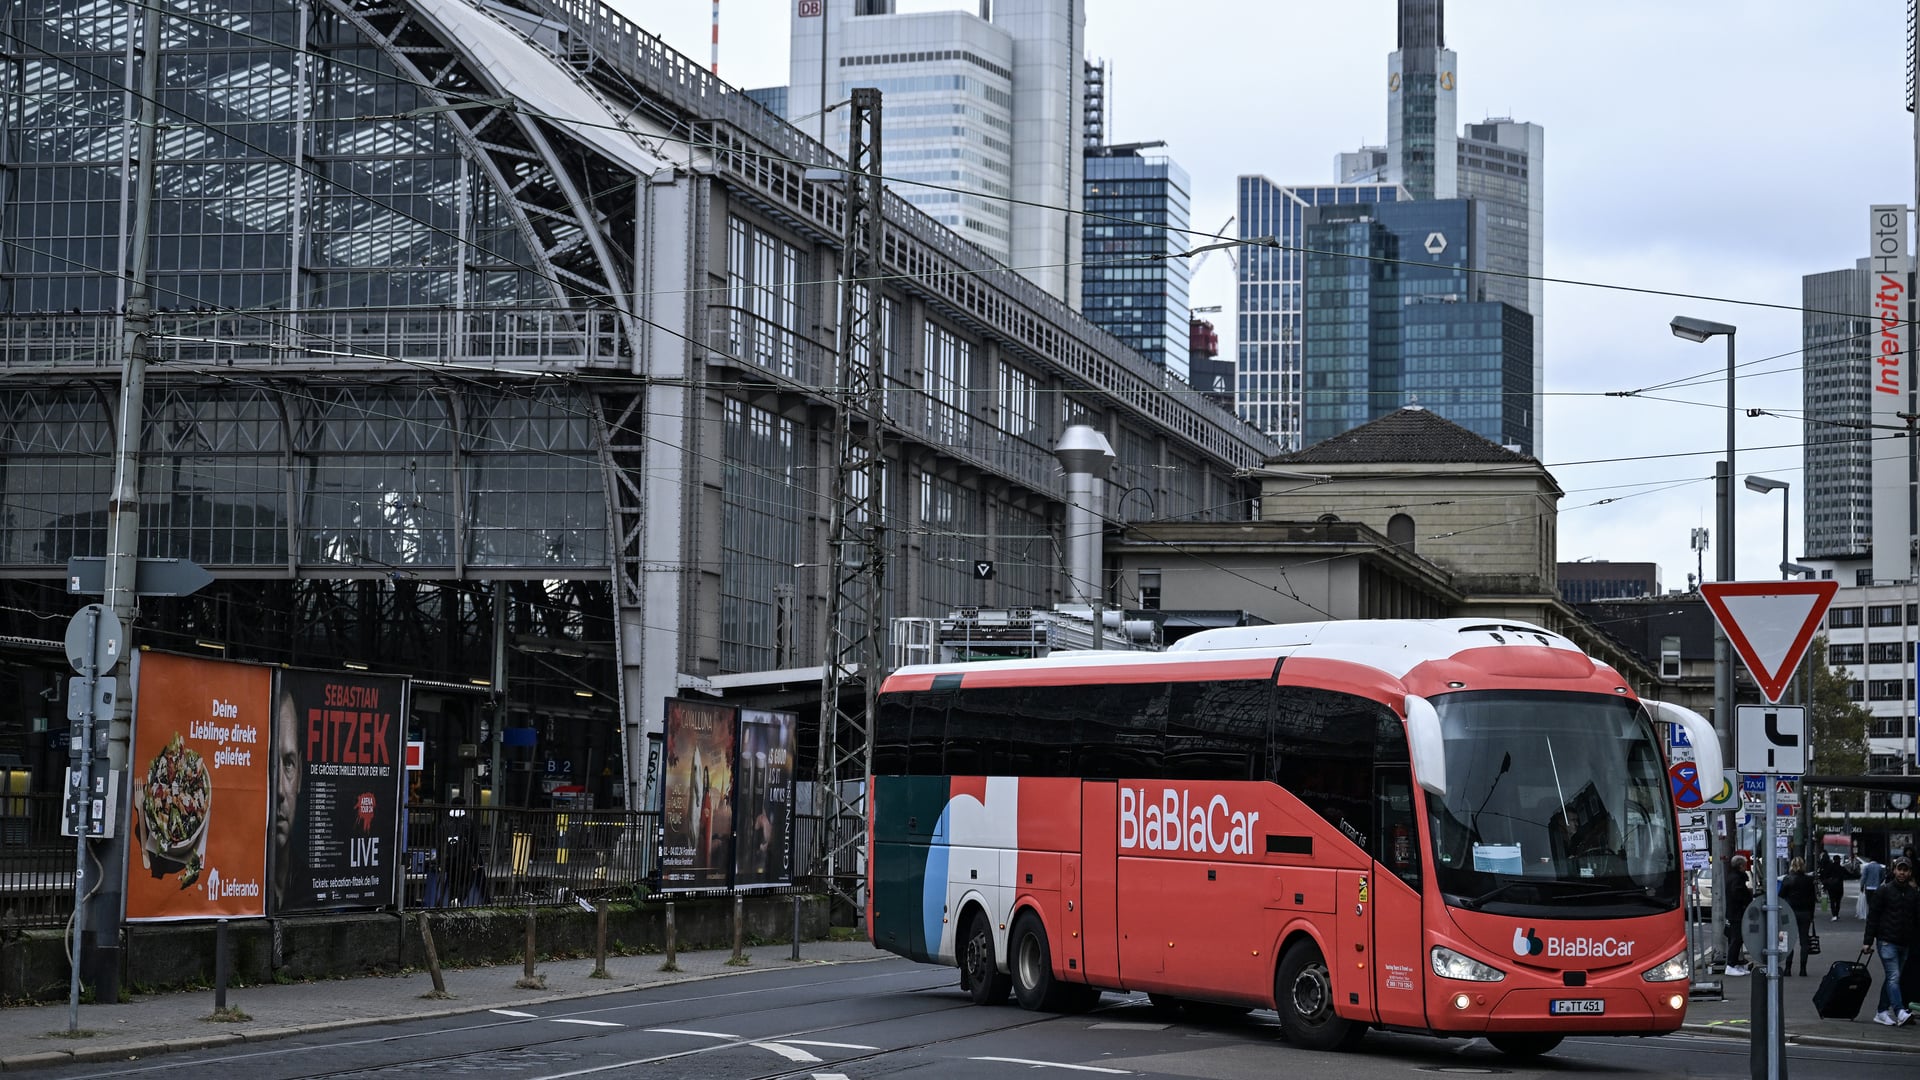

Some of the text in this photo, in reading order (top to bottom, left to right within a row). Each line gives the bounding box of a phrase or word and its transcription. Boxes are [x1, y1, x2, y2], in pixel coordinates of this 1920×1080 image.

[801, 1, 820, 15] DB
[324, 683, 379, 709] SEBASTIAN
[212, 698, 238, 718] Deine
[190, 720, 257, 745] Lieblinge direkt
[307, 708, 391, 765] FITZEK
[214, 746, 251, 769] geliefert
[547, 760, 571, 772] B 2
[310, 764, 319, 775] DIE
[357, 766, 369, 776] TOUR
[369, 766, 378, 776] DER
[379, 766, 390, 777] WELT
[1745, 780, 1765, 789] TAXI
[1121, 787, 1259, 855] BlaBlaCar
[350, 837, 380, 867] LIVE
[221, 878, 259, 897] Lieferando
[1547, 936, 1635, 957] BlaBlaCar
[1559, 1001, 1600, 1011] F TT 451
